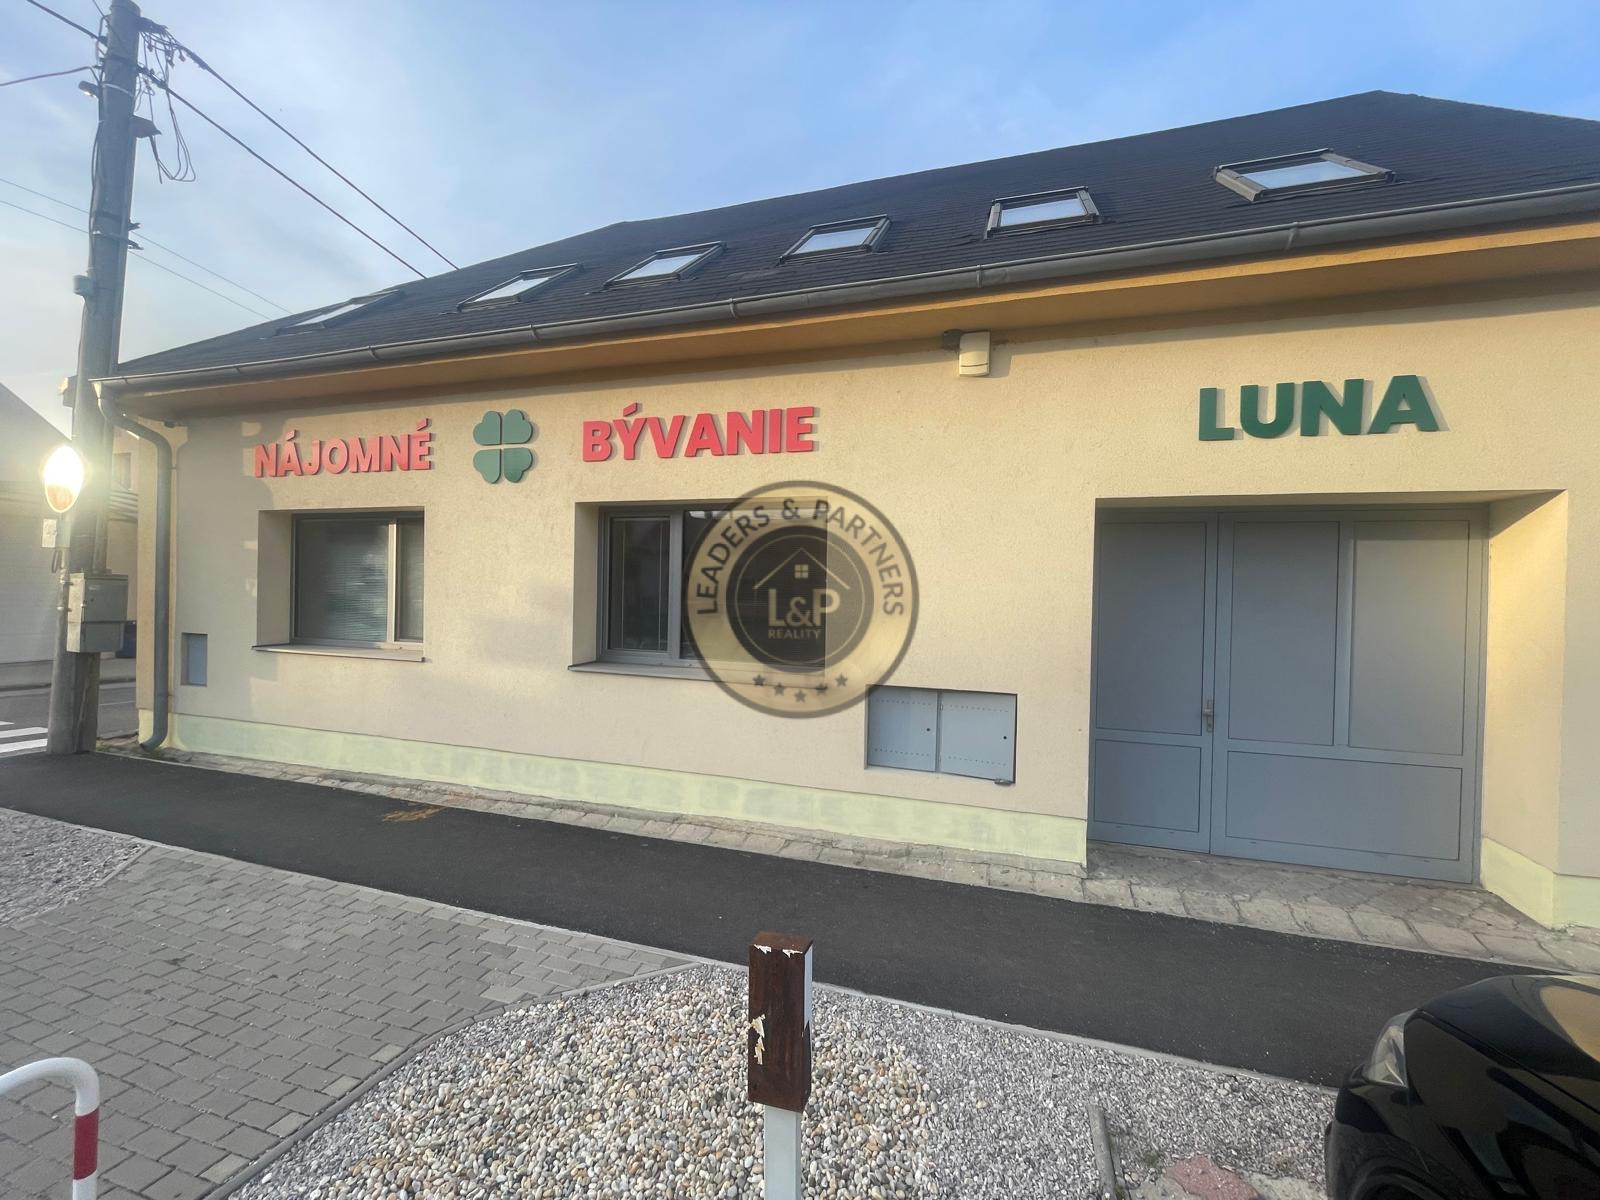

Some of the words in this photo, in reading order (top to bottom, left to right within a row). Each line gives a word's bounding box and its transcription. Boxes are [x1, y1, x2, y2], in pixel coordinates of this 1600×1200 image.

[254, 418, 433, 478] NÁJOMNÉ
[582, 402, 815, 462] BÝVANIE
[1199, 375, 1440, 441] LUNA
